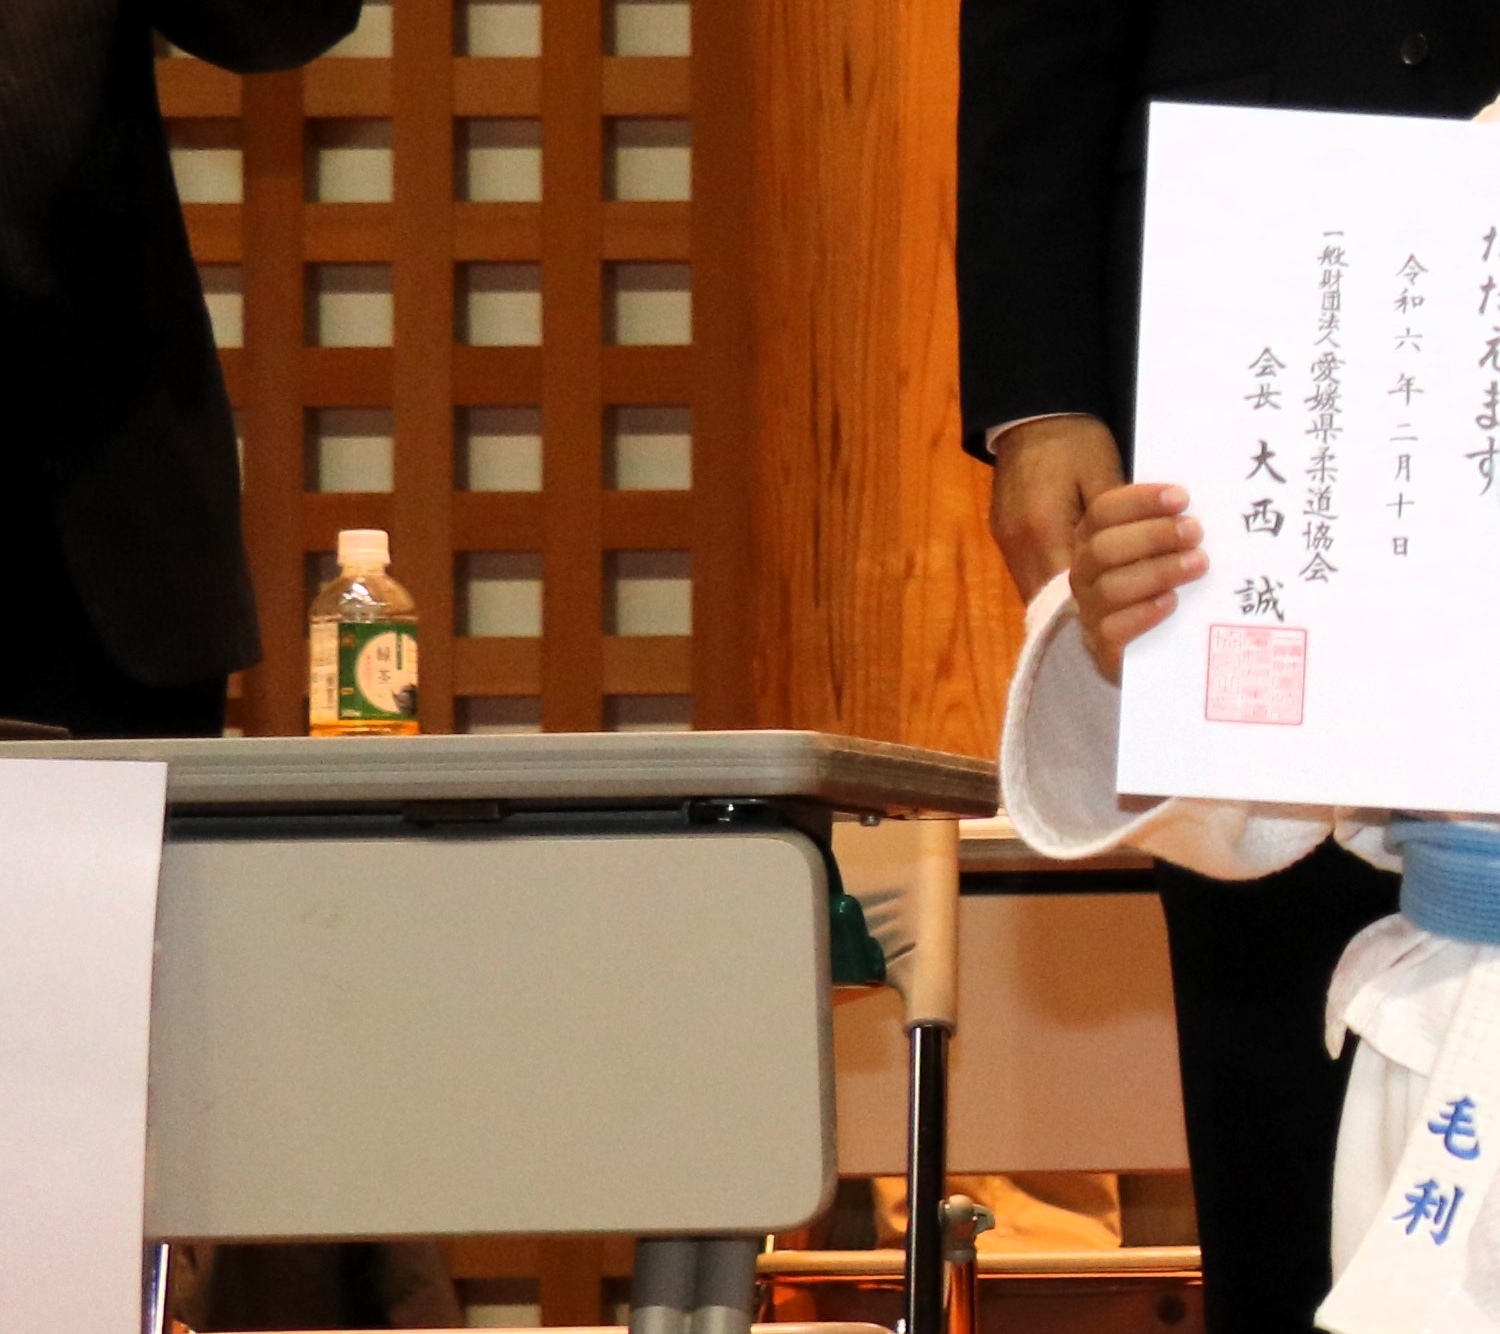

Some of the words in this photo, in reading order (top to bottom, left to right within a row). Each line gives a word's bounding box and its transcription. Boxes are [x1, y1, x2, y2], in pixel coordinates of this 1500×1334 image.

[1386, 253, 1428, 557] 令和六年二月十日
[1391, 1093, 1481, 1246] 毛利
